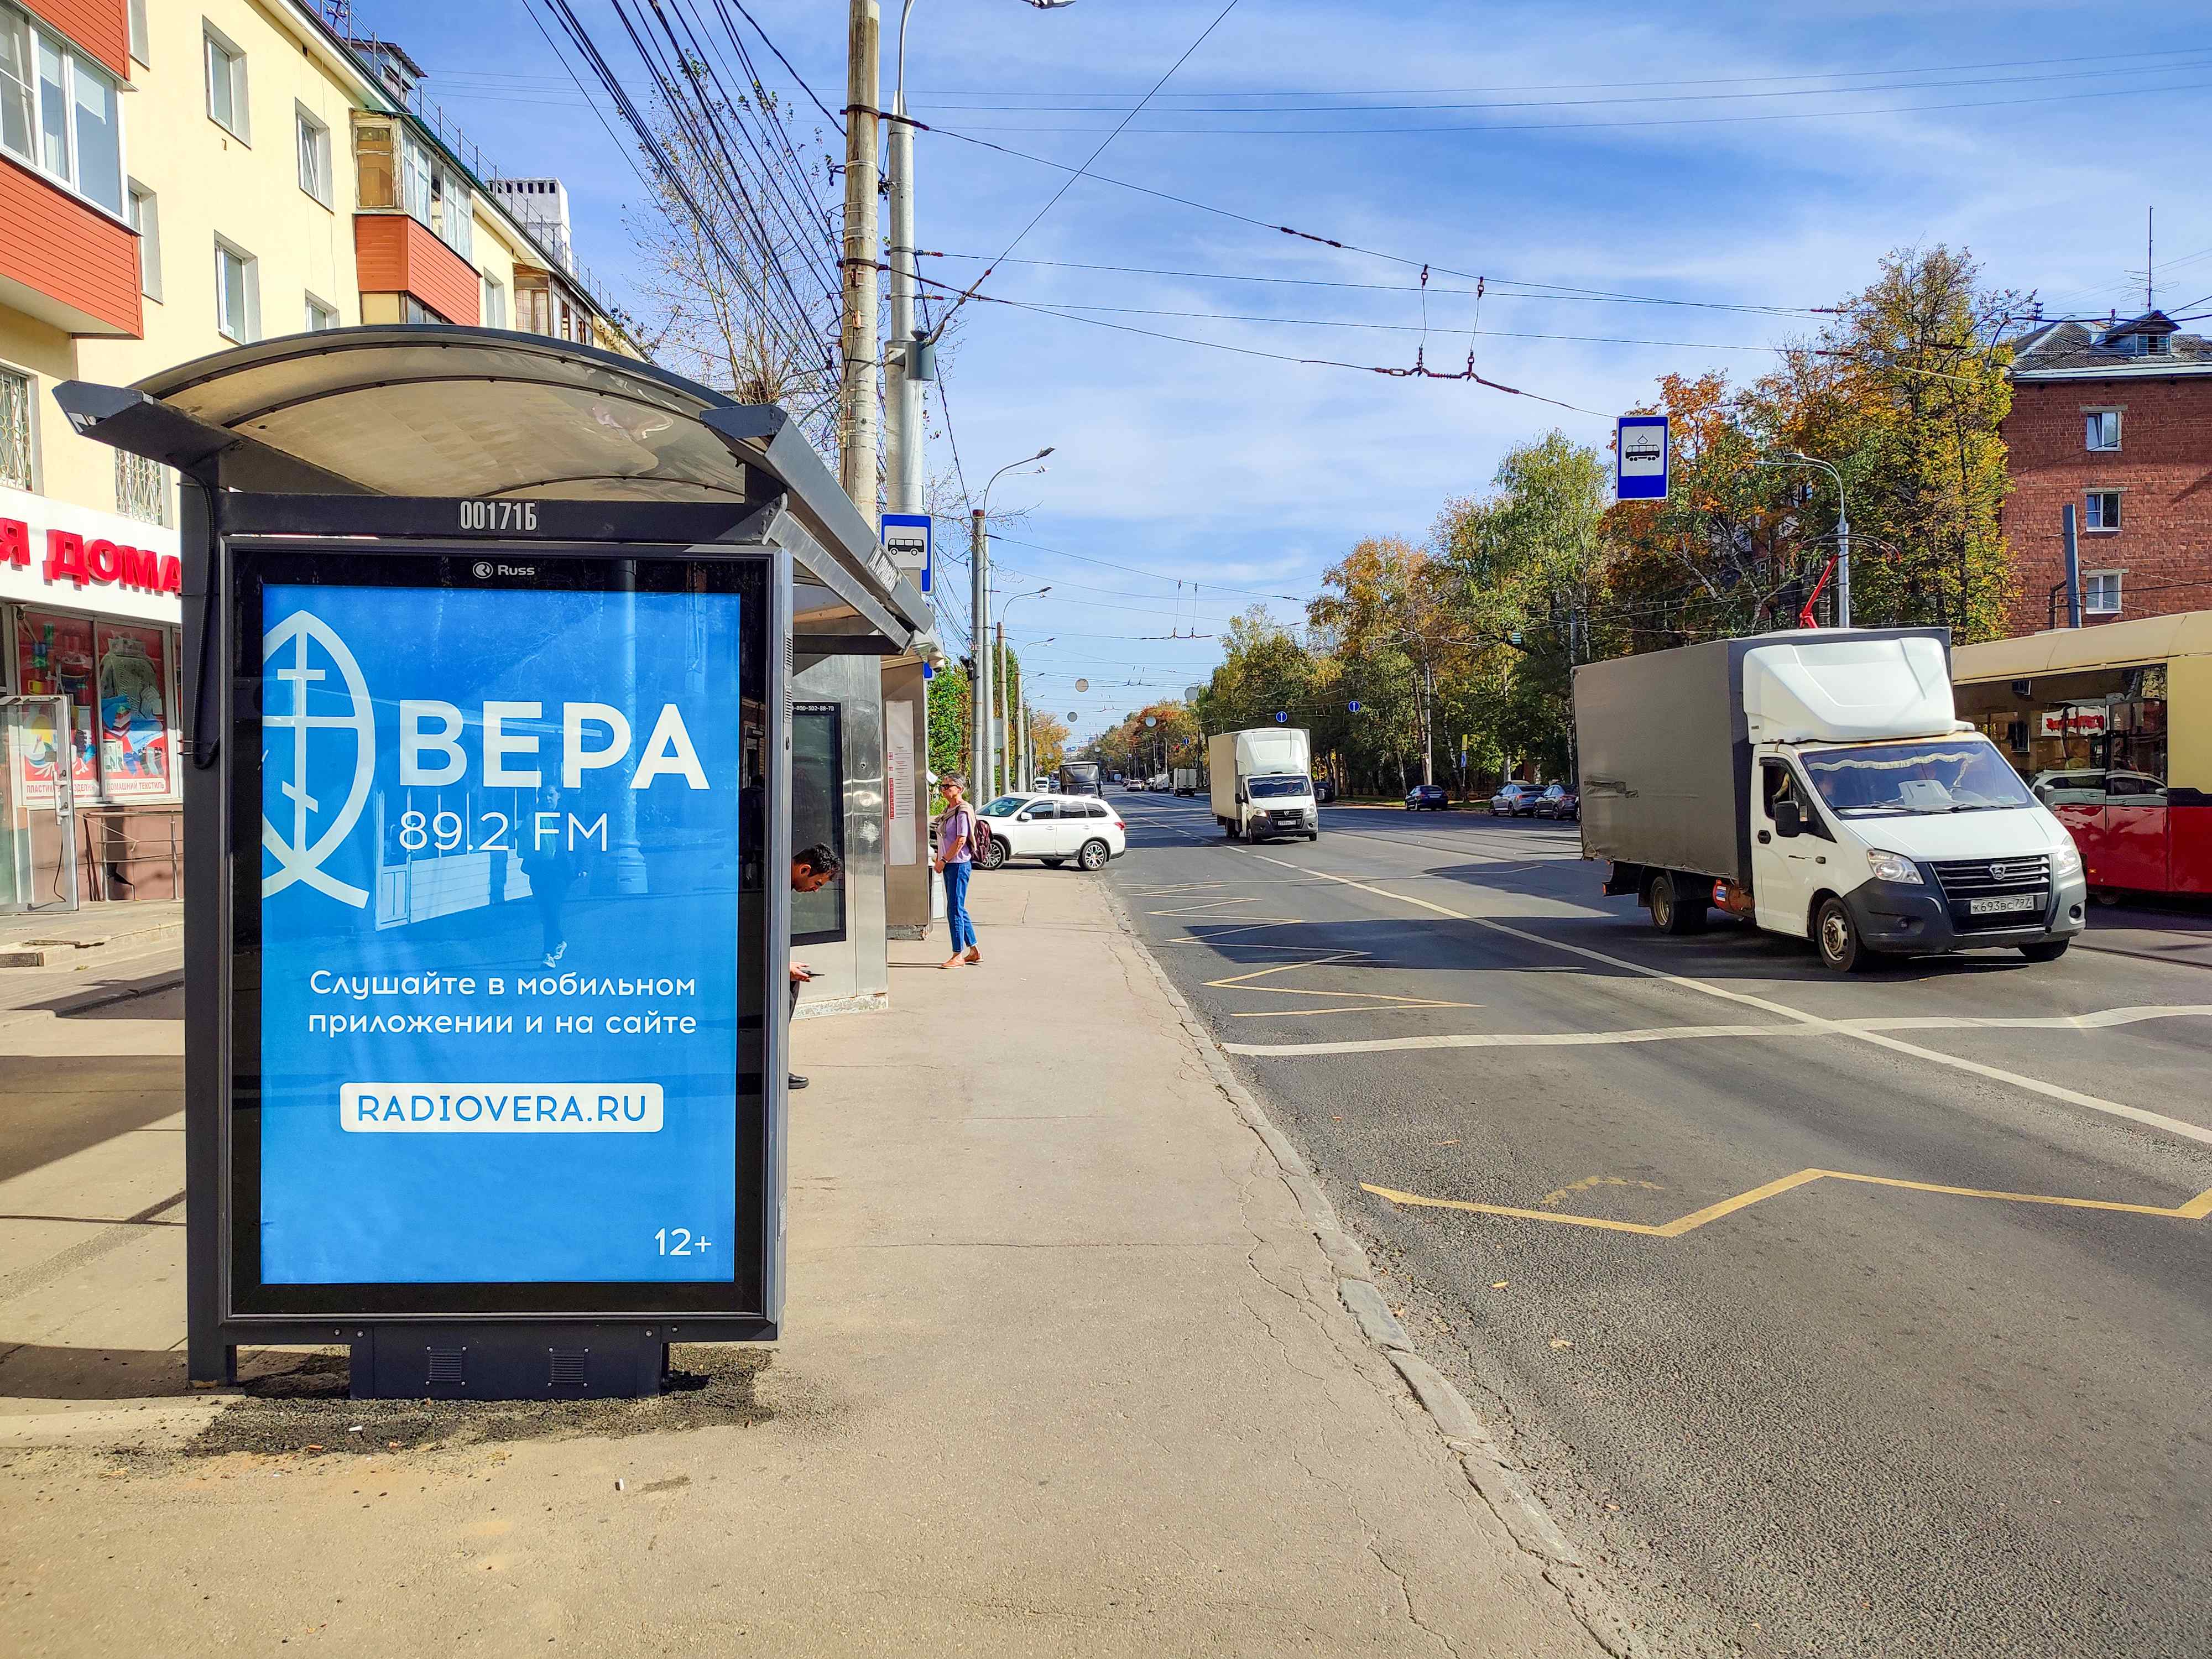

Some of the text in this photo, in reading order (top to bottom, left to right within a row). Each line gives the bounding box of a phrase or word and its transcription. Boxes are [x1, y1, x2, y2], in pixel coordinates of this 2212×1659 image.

[43, 529, 182, 597] ДОМА
[498, 565, 535, 576] Russ
[399, 701, 711, 790] ВЕРА
[106, 781, 164, 791] ДОМАШНИЙ ТЕКСТИЛЬ
[399, 811, 608, 852] 89.2 FM
[310, 970, 695, 1000] Слушайте в мобильном
[309, 1010, 697, 1038] приложении и на сайте
[358, 1095, 646, 1122] RADIOVERA.RU
[654, 1228, 712, 1256] 12+
